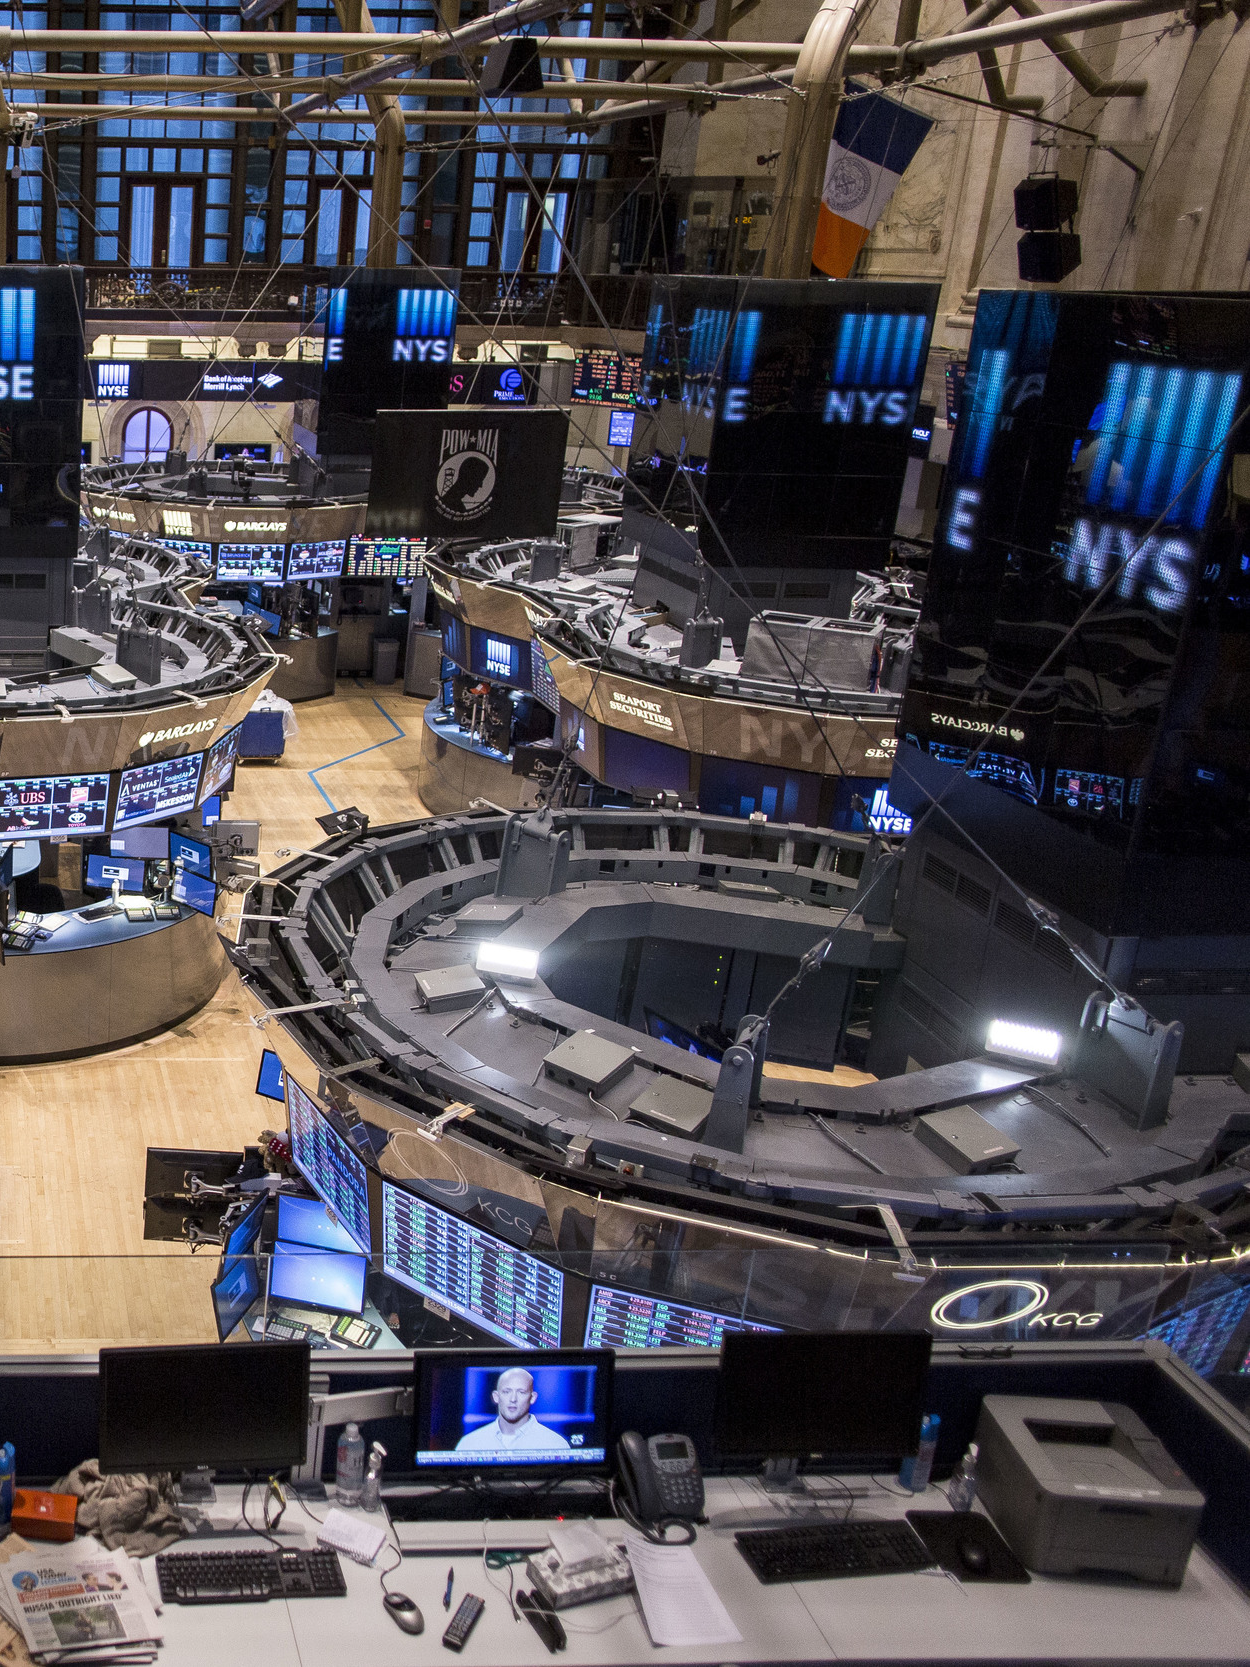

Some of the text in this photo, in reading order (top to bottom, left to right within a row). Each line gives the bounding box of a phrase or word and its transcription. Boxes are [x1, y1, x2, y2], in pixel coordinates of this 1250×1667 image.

[203, 375, 217, 383] Bank
[97, 386, 129, 396] NYSE
[203, 382, 225, 391] Merrill
[493, 389, 515, 398] PRIME
[438, 428, 499, 466] POW MIA
[165, 525, 194, 536] NYSE
[236, 520, 288, 532] BARCLAYS
[486, 659, 511, 677] NYSE
[613, 691, 662, 714] SEAPORT
[609, 700, 673, 727] SECURITIES
[152, 718, 218, 744] BARCLAYS
[131, 779, 158, 792] VENTAS
[20, 791, 46, 804] UBS
[869, 816, 912, 832] NYSE
[326, 1148, 366, 1200] PANDORA
[477, 1196, 533, 1236] KCG
[598, 1290, 614, 1298] AMID
[656, 1303, 669, 1311] EGO
[655, 1312, 671, 1320] EMES
[1027, 1312, 1104, 1327] KCG
[654, 1320, 666, 1328] EOG
[652, 1328, 667, 1336] FELP
[36, 1567, 56, 1576] USA
[23, 1593, 123, 1614] RUSSIA 'OUTRIGHT LIED'
